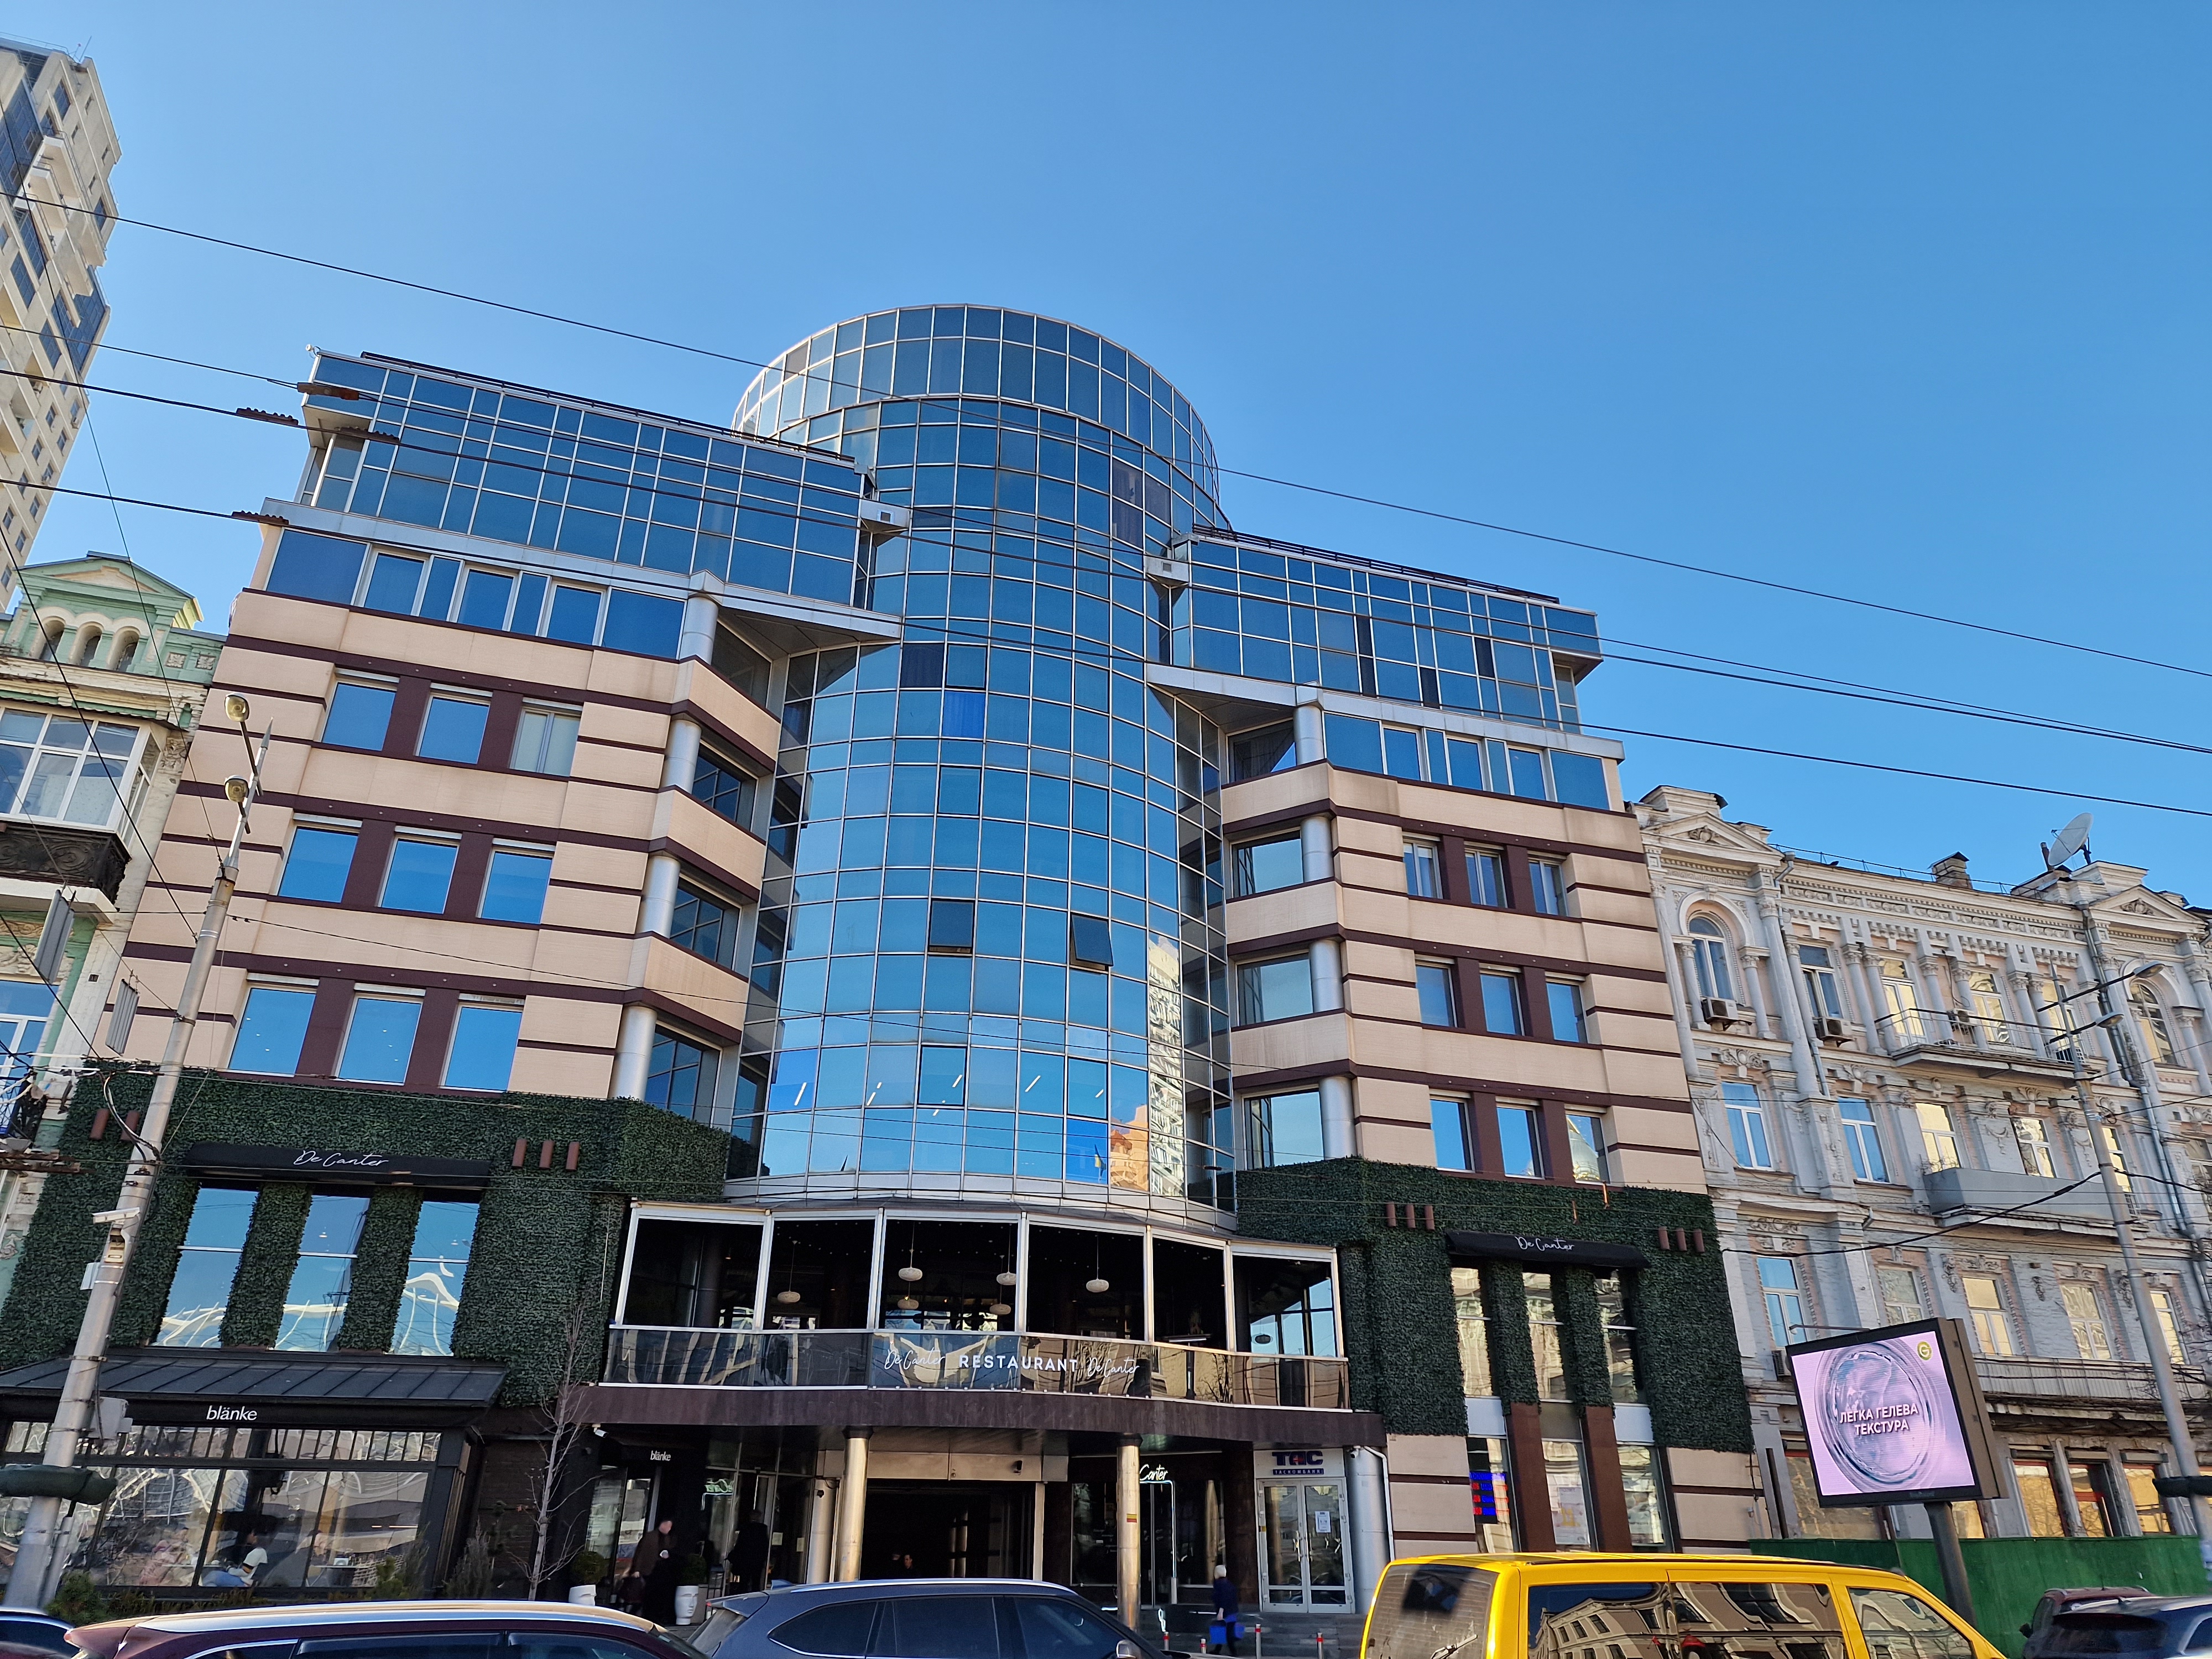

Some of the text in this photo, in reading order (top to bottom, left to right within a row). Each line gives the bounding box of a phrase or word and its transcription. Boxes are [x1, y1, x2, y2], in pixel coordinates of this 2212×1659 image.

[293, 1150, 389, 1167] De Canter
[1514, 1236, 1575, 1251] De Canter
[884, 1347, 1141, 1378] De Canter RESTAURANT De Canter
[206, 1405, 258, 1421] blänke
[1839, 1403, 1918, 1423] ЛЕГКА ГЕЛЕВА
[1854, 1418, 1909, 1436] ТЕКСТУРА
[650, 1450, 671, 1461] blänke
[1139, 1463, 1168, 1481] Canter
